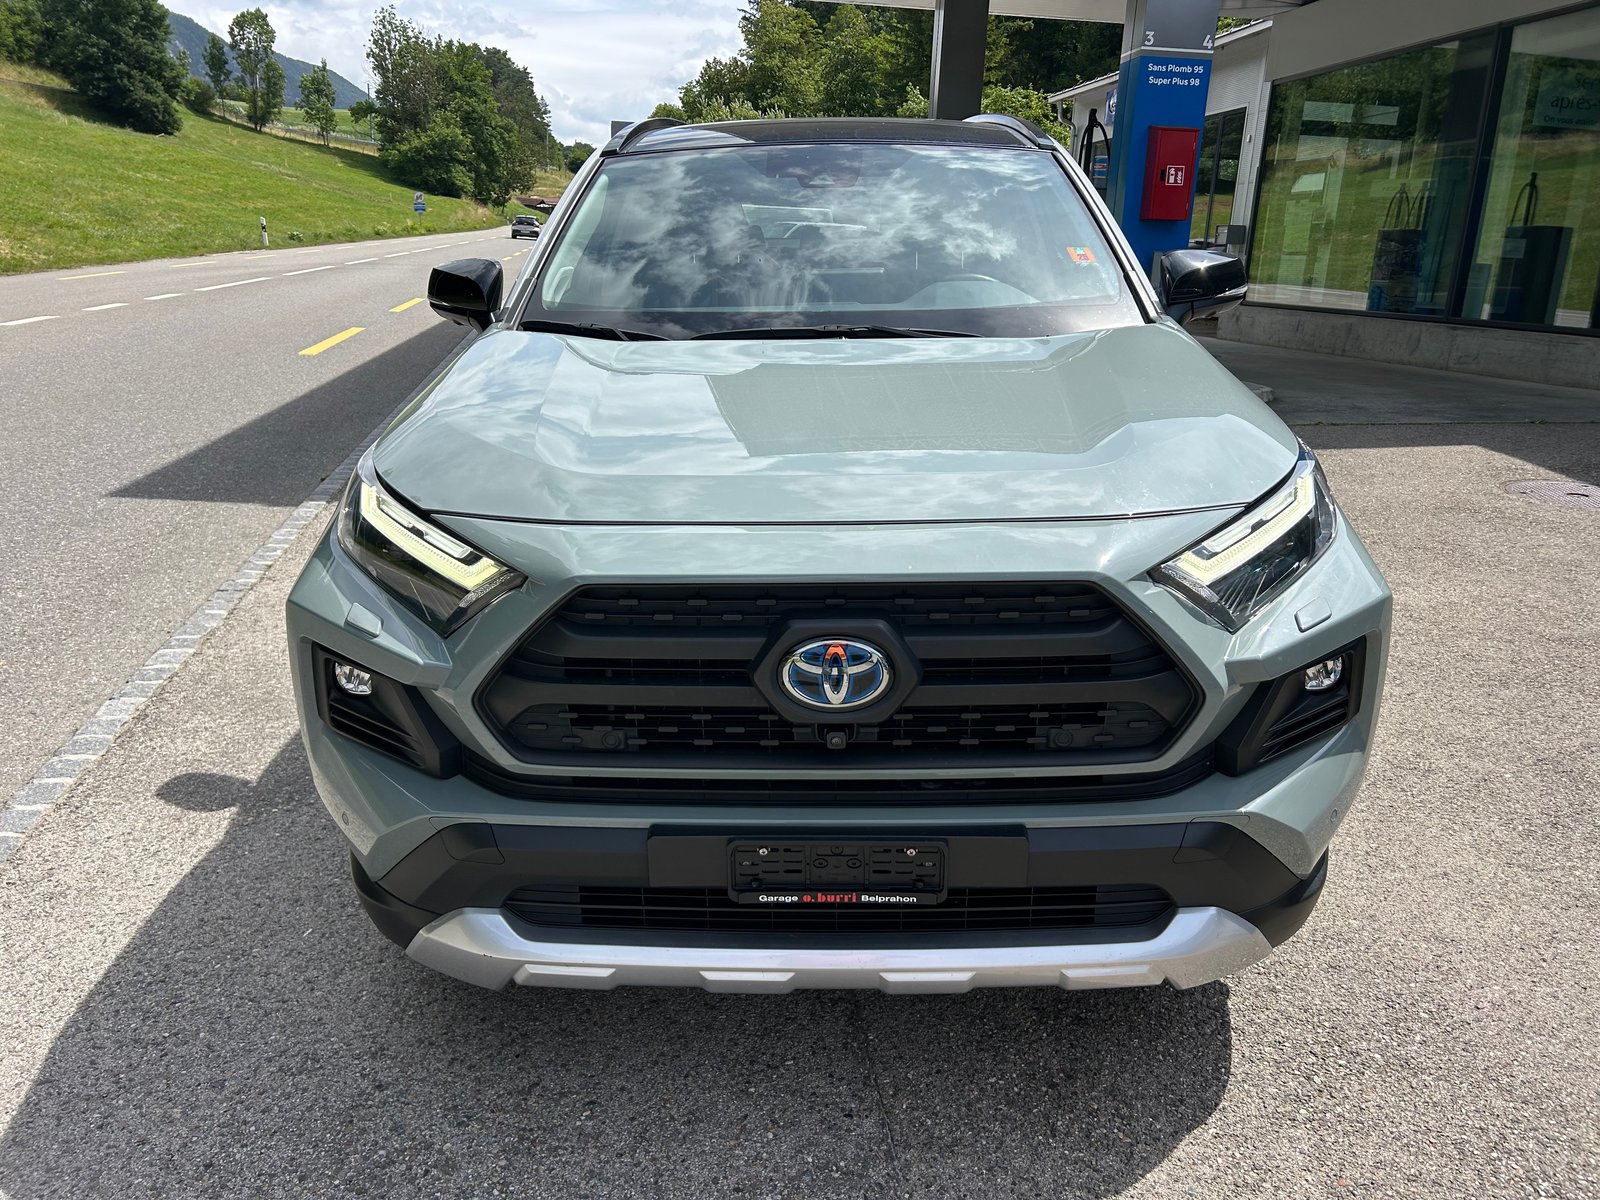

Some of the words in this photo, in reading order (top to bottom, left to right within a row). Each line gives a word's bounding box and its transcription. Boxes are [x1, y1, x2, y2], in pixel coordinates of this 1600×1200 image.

[1144, 31, 1154, 45] 3
[1202, 34, 1213, 49] 4
[1147, 63, 1167, 72] Sans
[1168, 64, 1192, 73] Plomb
[1193, 65, 1204, 74] 95
[1148, 75, 1171, 86] Super
[1172, 77, 1188, 86] Plus
[1189, 78, 1200, 86] 98
[758, 894, 799, 903] Garage
[861, 894, 917, 903] Belprahon
